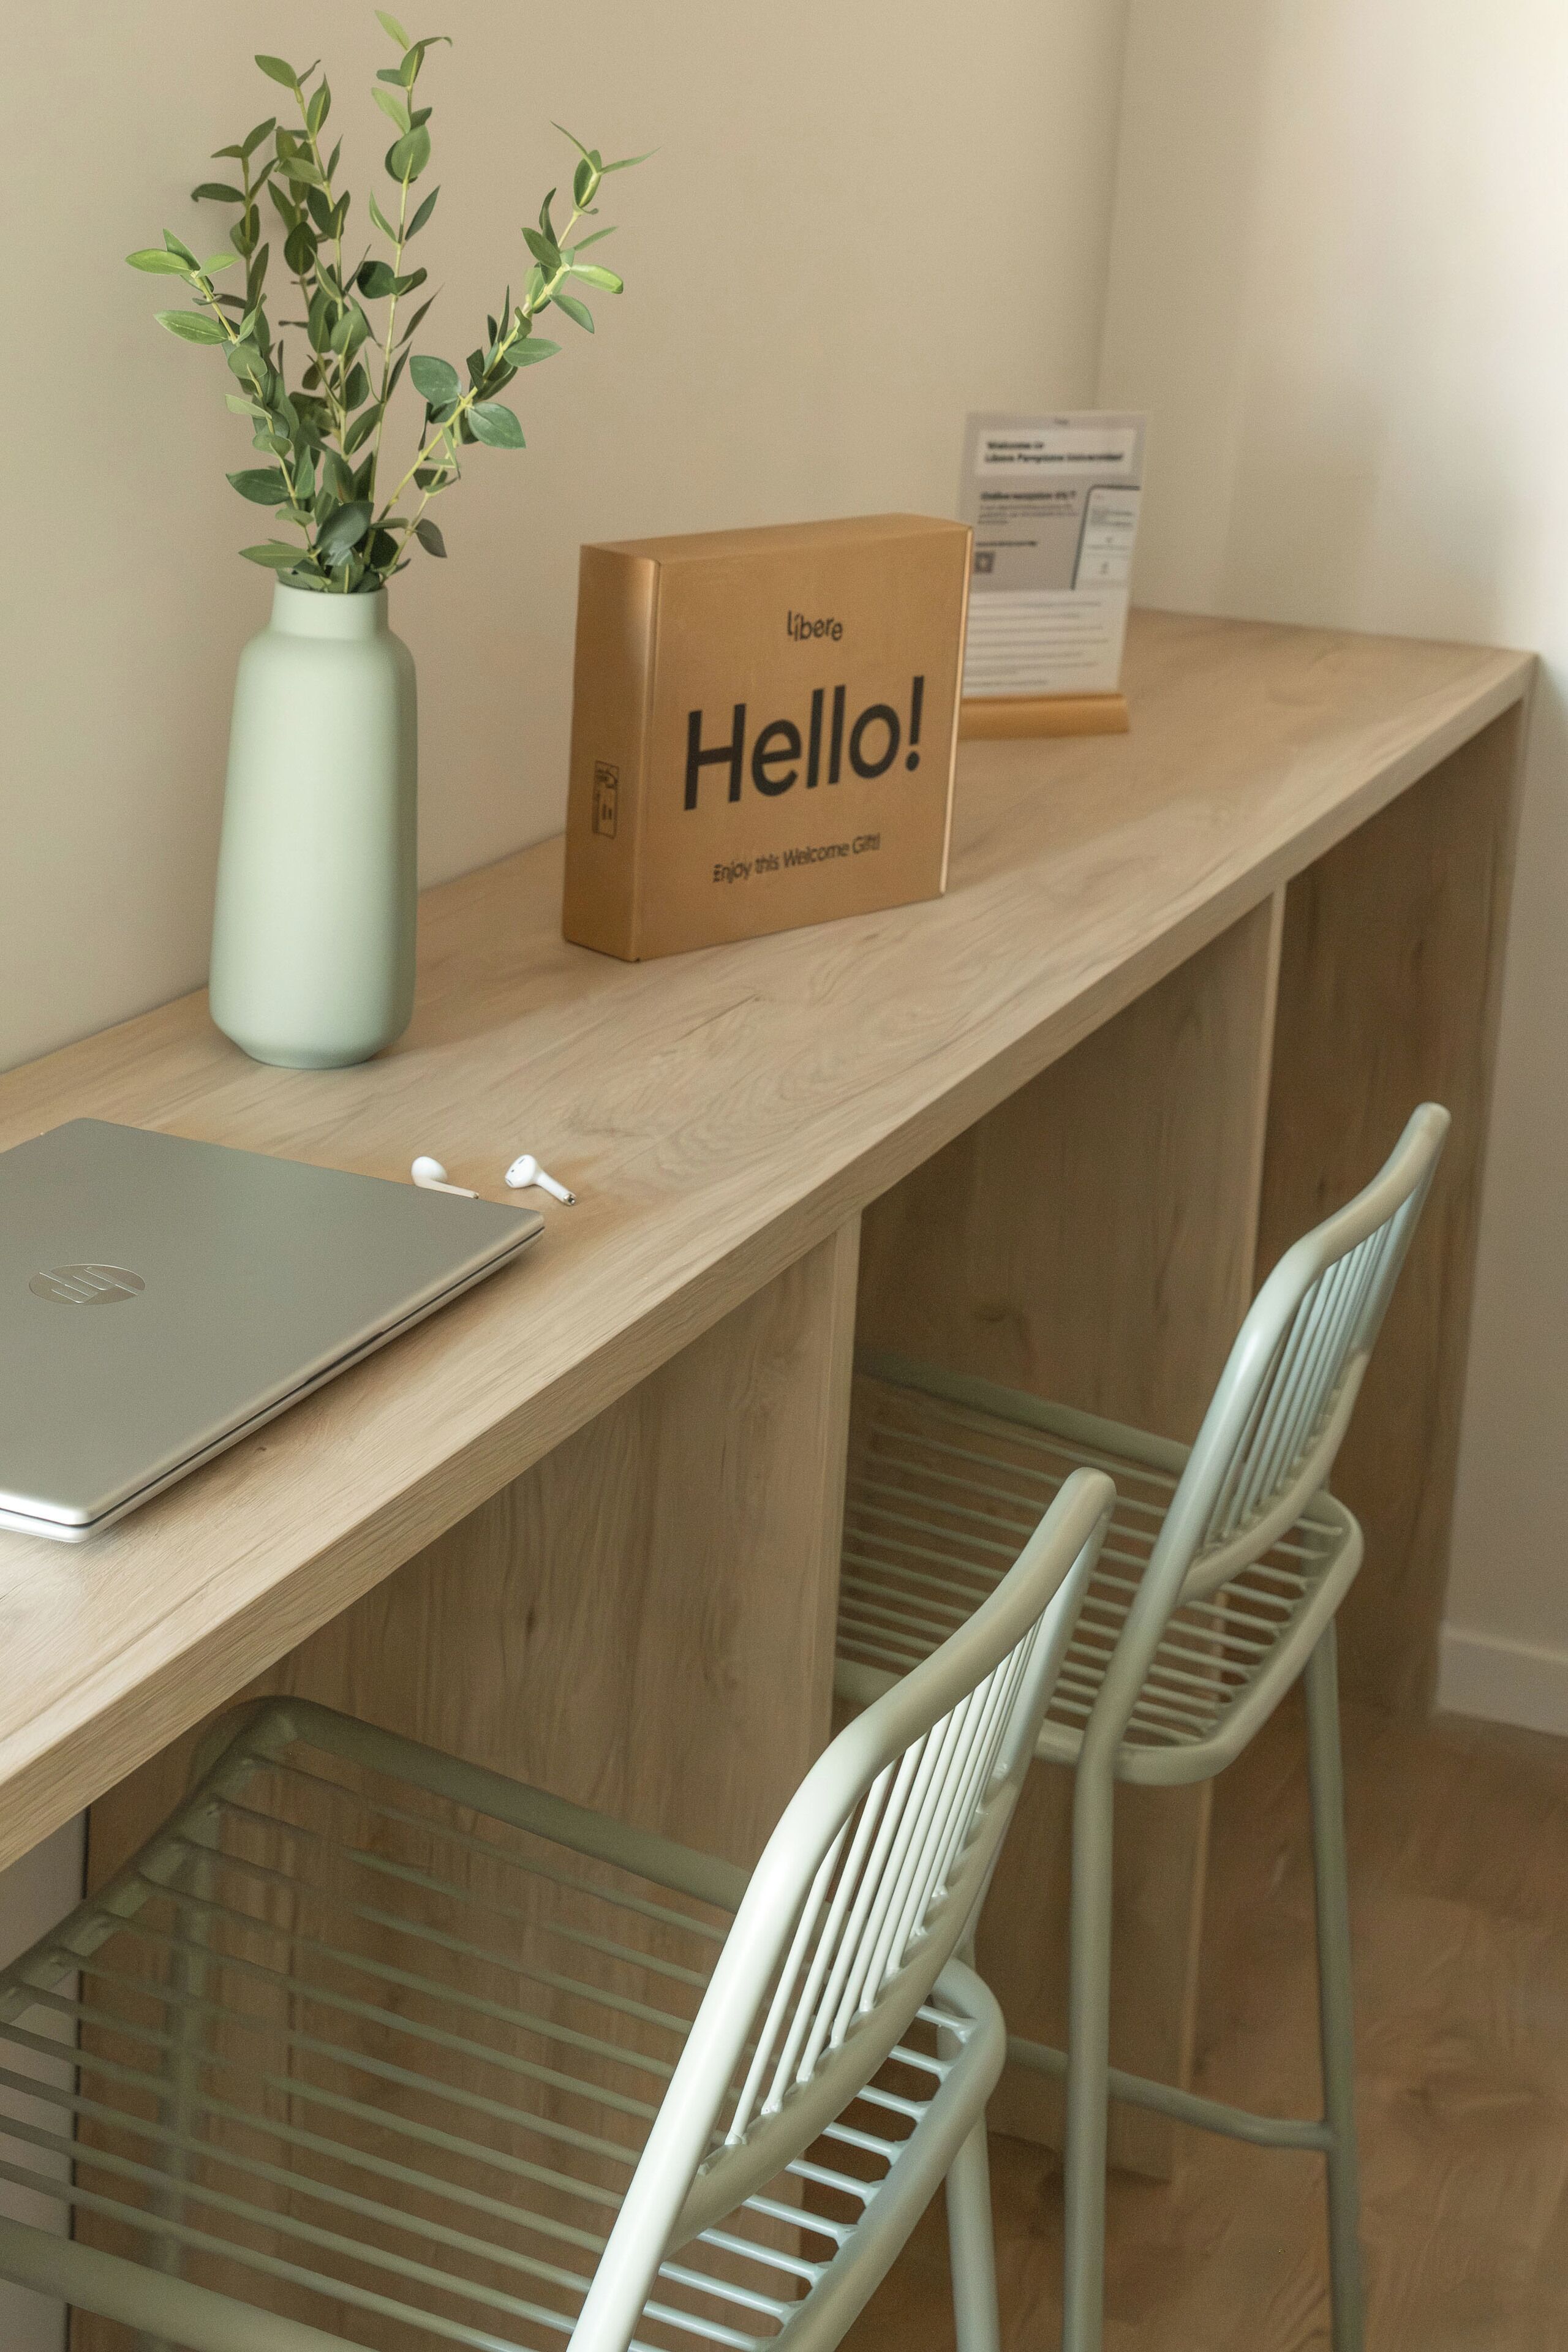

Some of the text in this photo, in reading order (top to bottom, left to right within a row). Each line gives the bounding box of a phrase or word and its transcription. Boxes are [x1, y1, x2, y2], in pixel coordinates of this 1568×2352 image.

[684, 676, 925, 812] Hello!
[712, 861, 753, 885] Enjoy
[755, 854, 780, 874] this
[783, 843, 850, 869] Welcome
